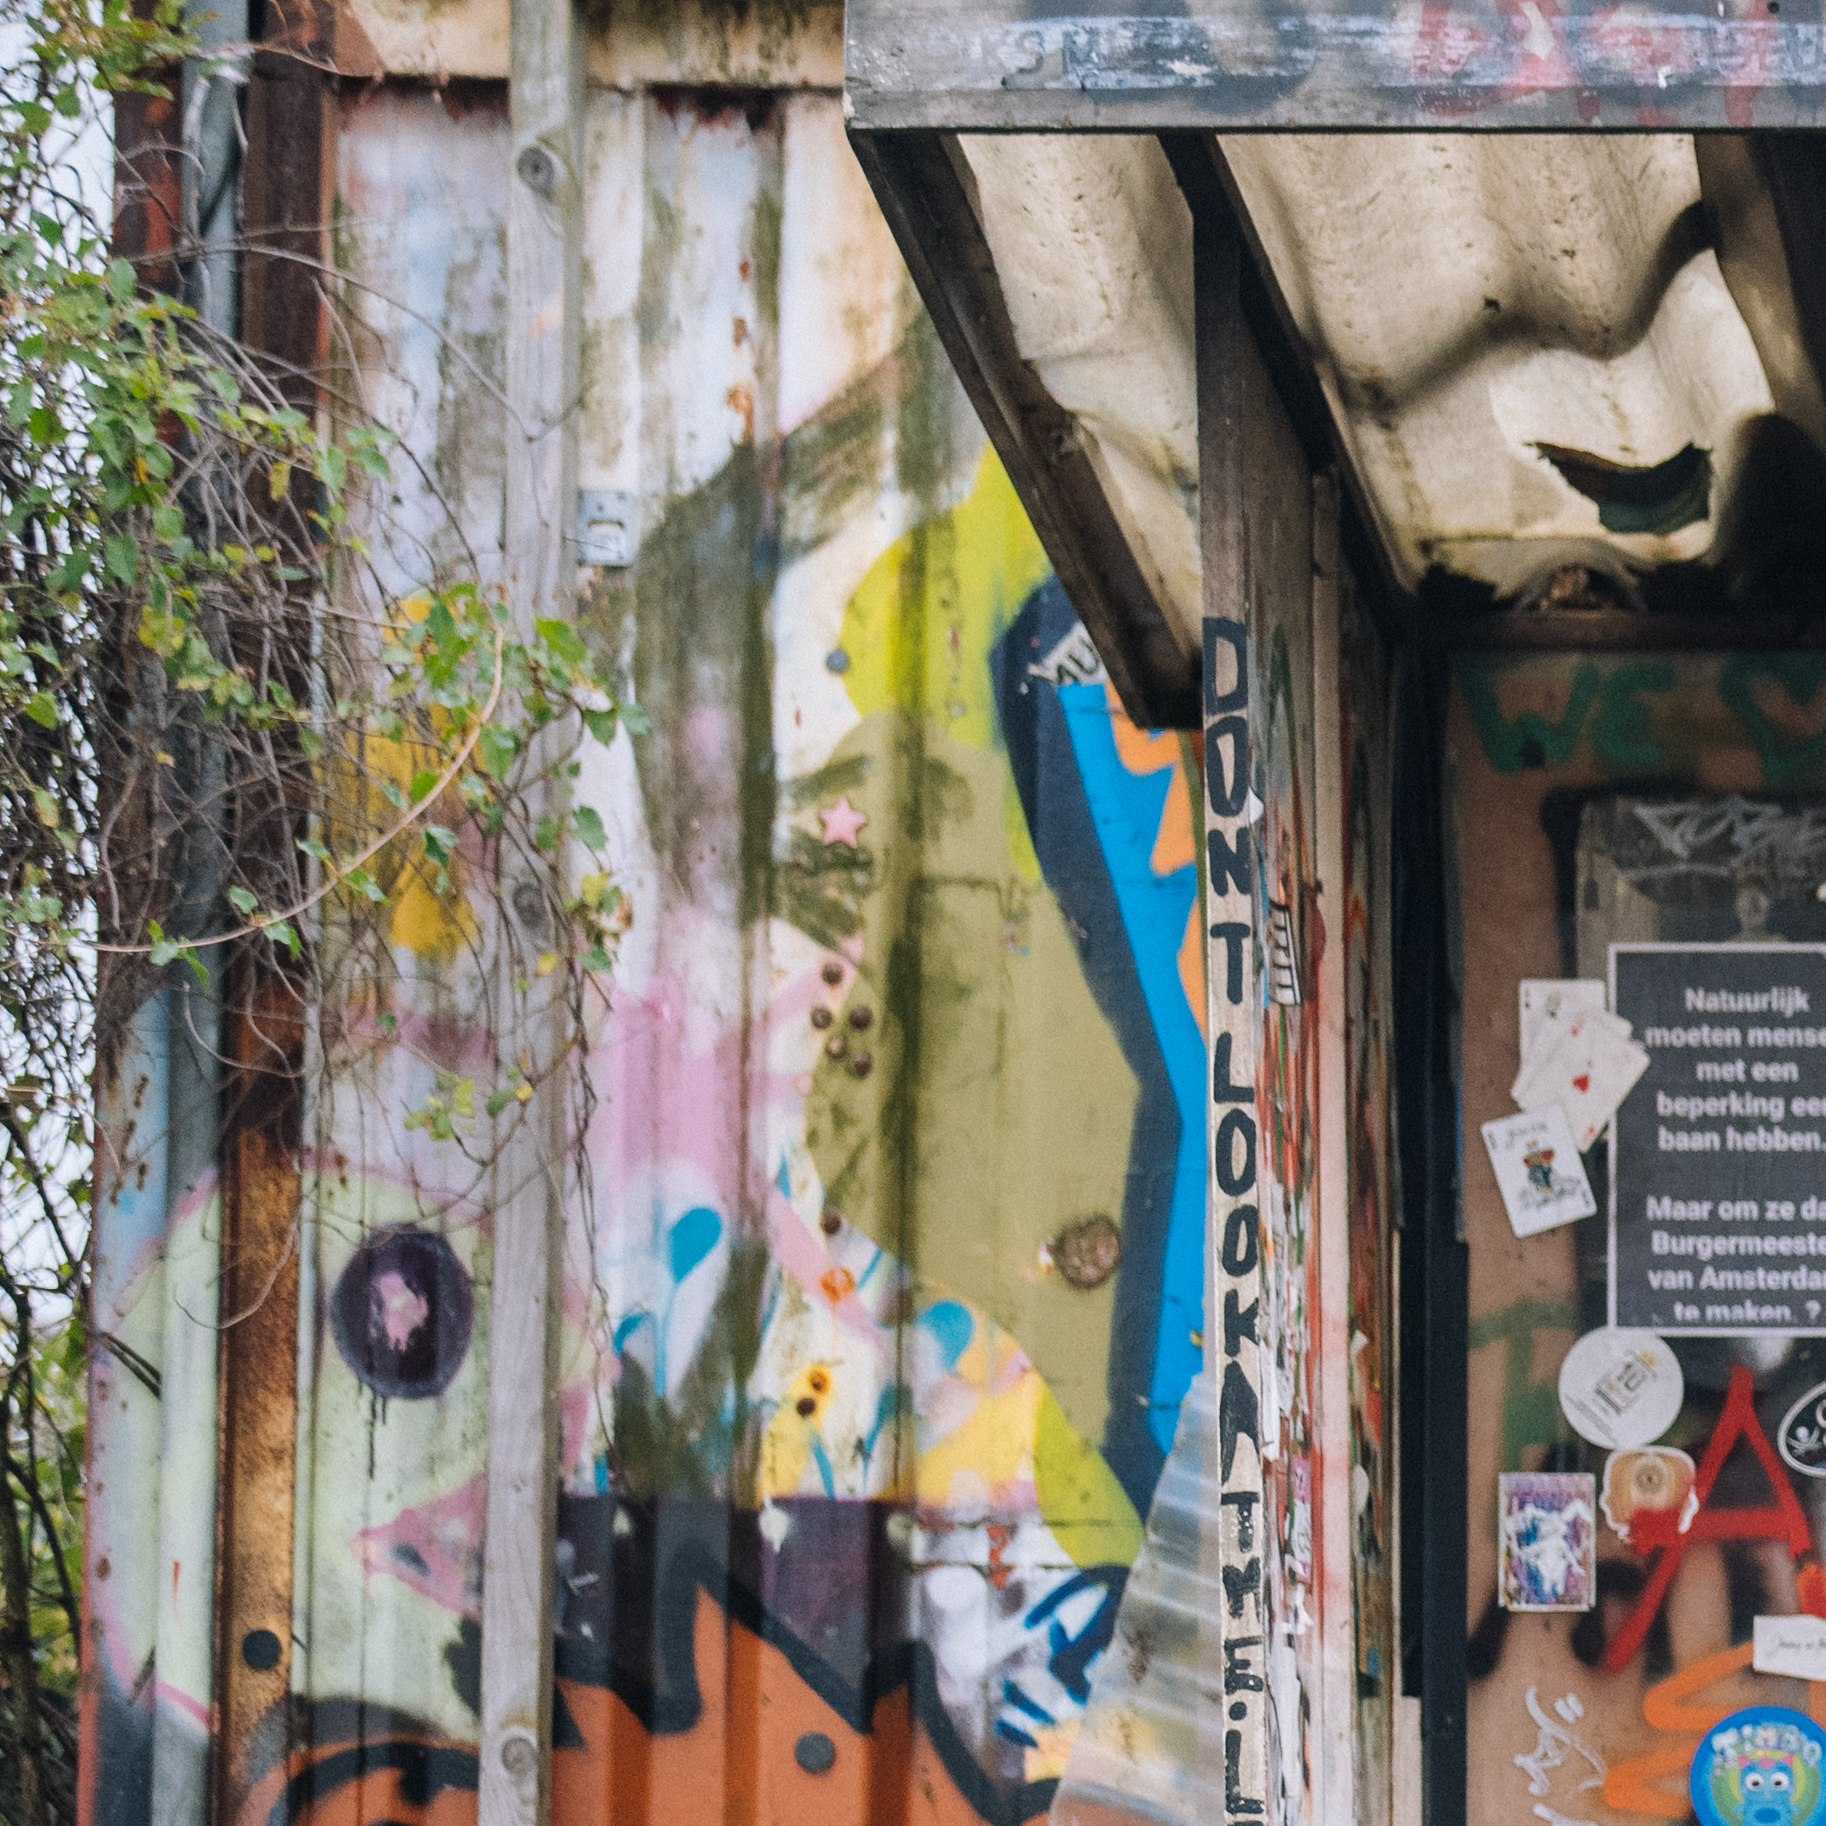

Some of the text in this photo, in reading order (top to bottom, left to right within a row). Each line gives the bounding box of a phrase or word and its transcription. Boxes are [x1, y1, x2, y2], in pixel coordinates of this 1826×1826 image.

[1684, 986, 1811, 1018] Natuurlijk
[1645, 1025, 1742, 1048] moeten
[1696, 1059, 1799, 1081] met een
[1656, 1090, 1786, 1121] beperking
[1657, 1127, 1720, 1151] baan
[1645, 1196, 1712, 1221] Maar
[1717, 1202, 1759, 1221] om
[1764, 1202, 1796, 1221] ze
[1647, 1271, 1694, 1290] van
[1674, 1303, 1701, 1321] te
